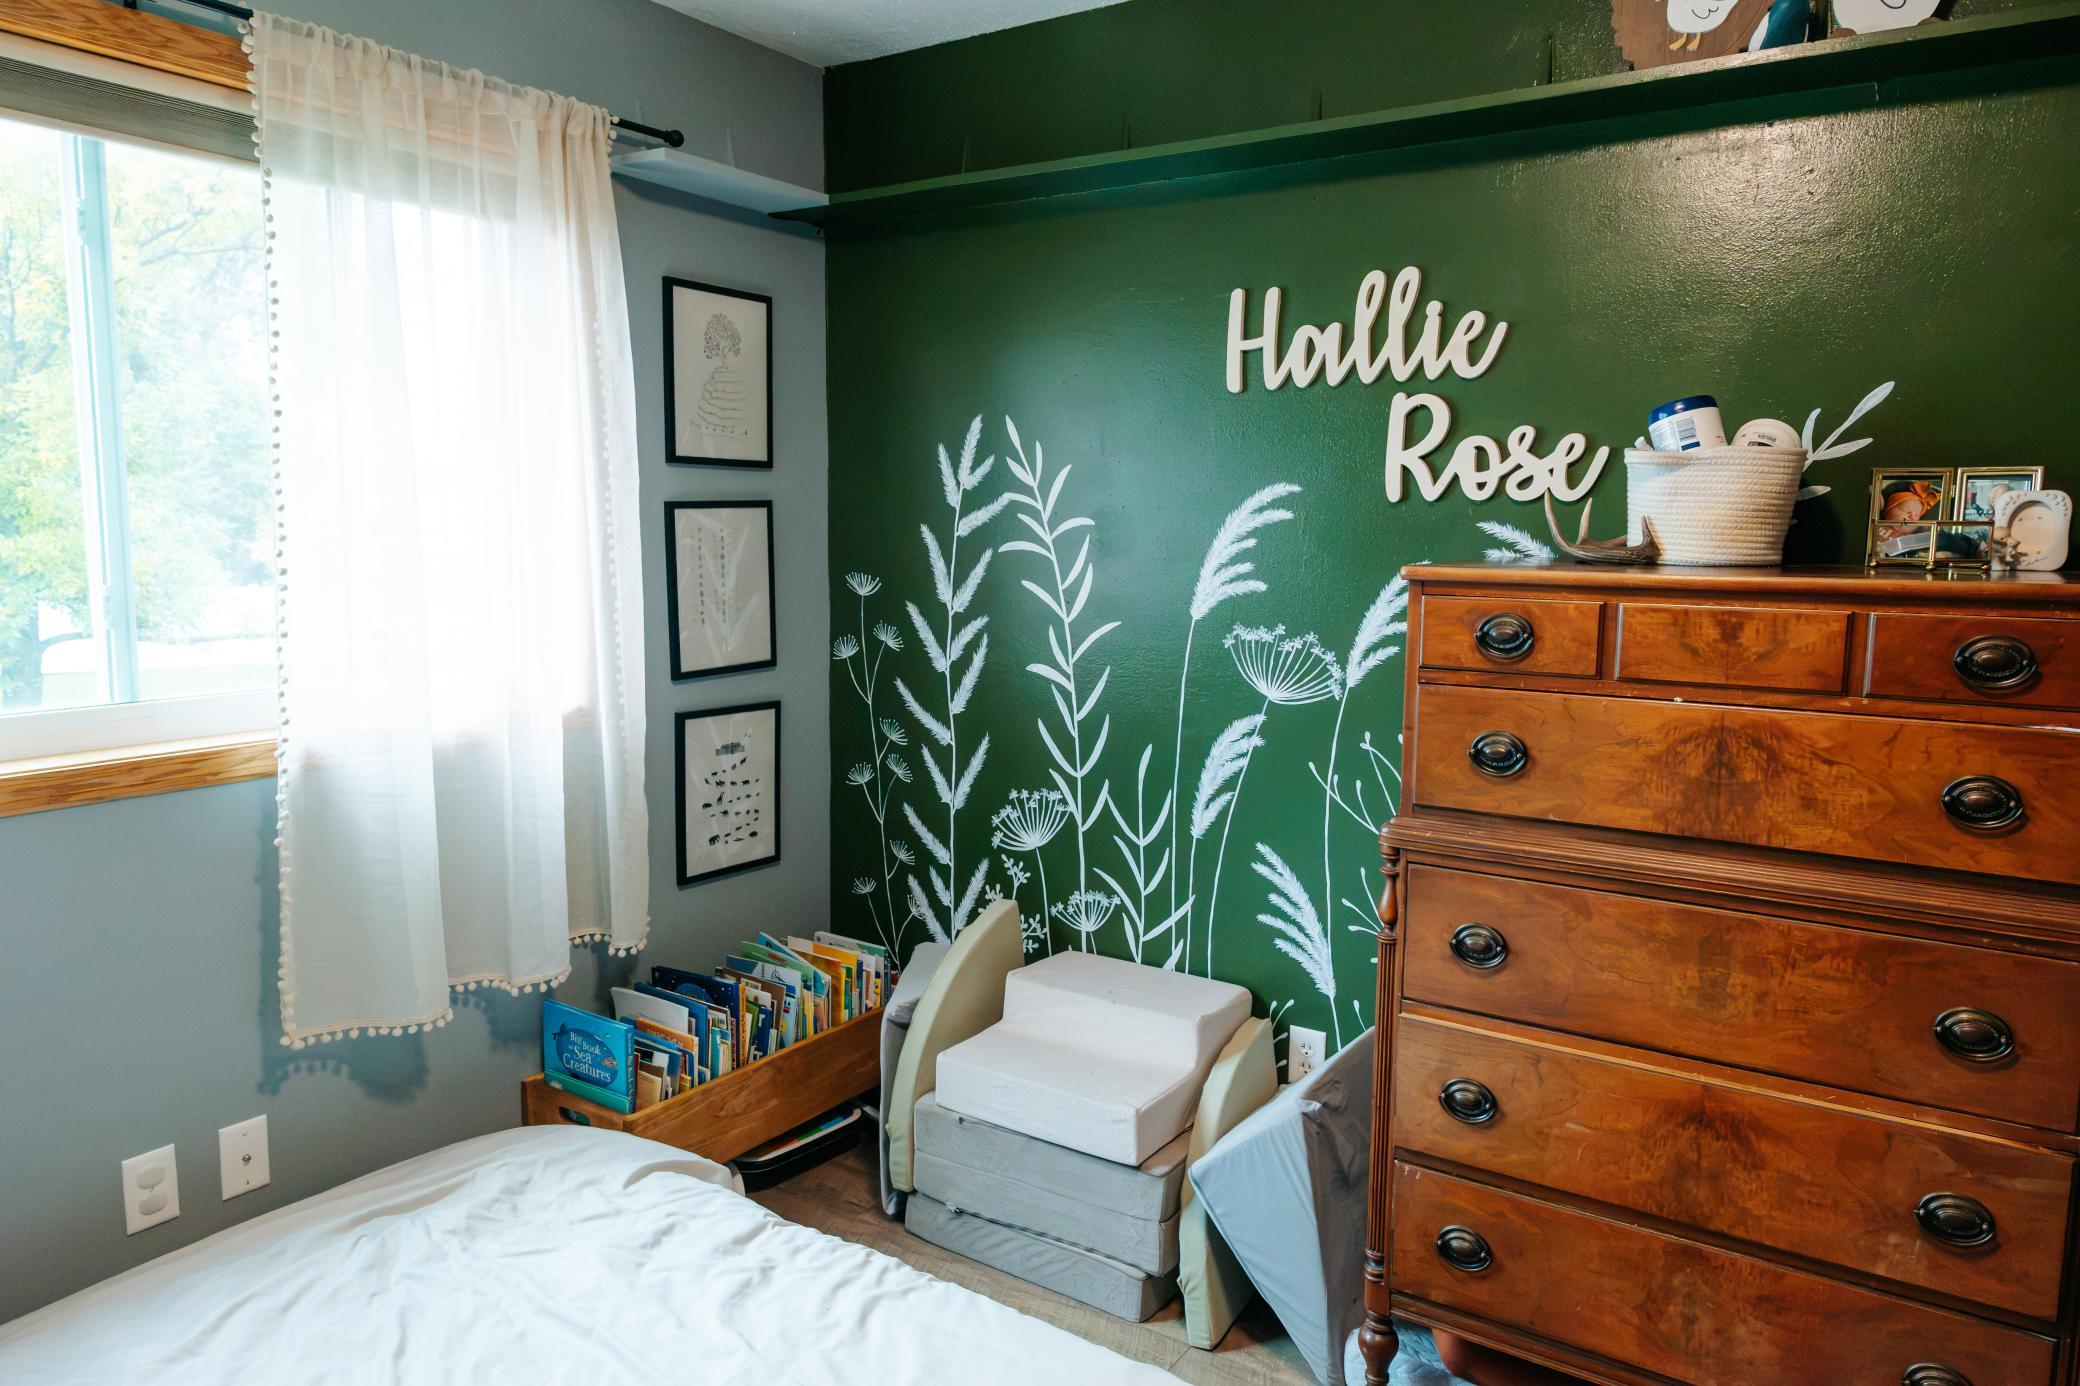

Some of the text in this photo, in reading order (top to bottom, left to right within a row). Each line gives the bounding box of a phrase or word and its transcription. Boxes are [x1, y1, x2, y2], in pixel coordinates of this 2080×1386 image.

[1226, 266, 1509, 393] Hallie
[1385, 392, 1610, 503] Rose
[563, 1053, 610, 1082] Creatures
[574, 1046, 592, 1063] Sea
